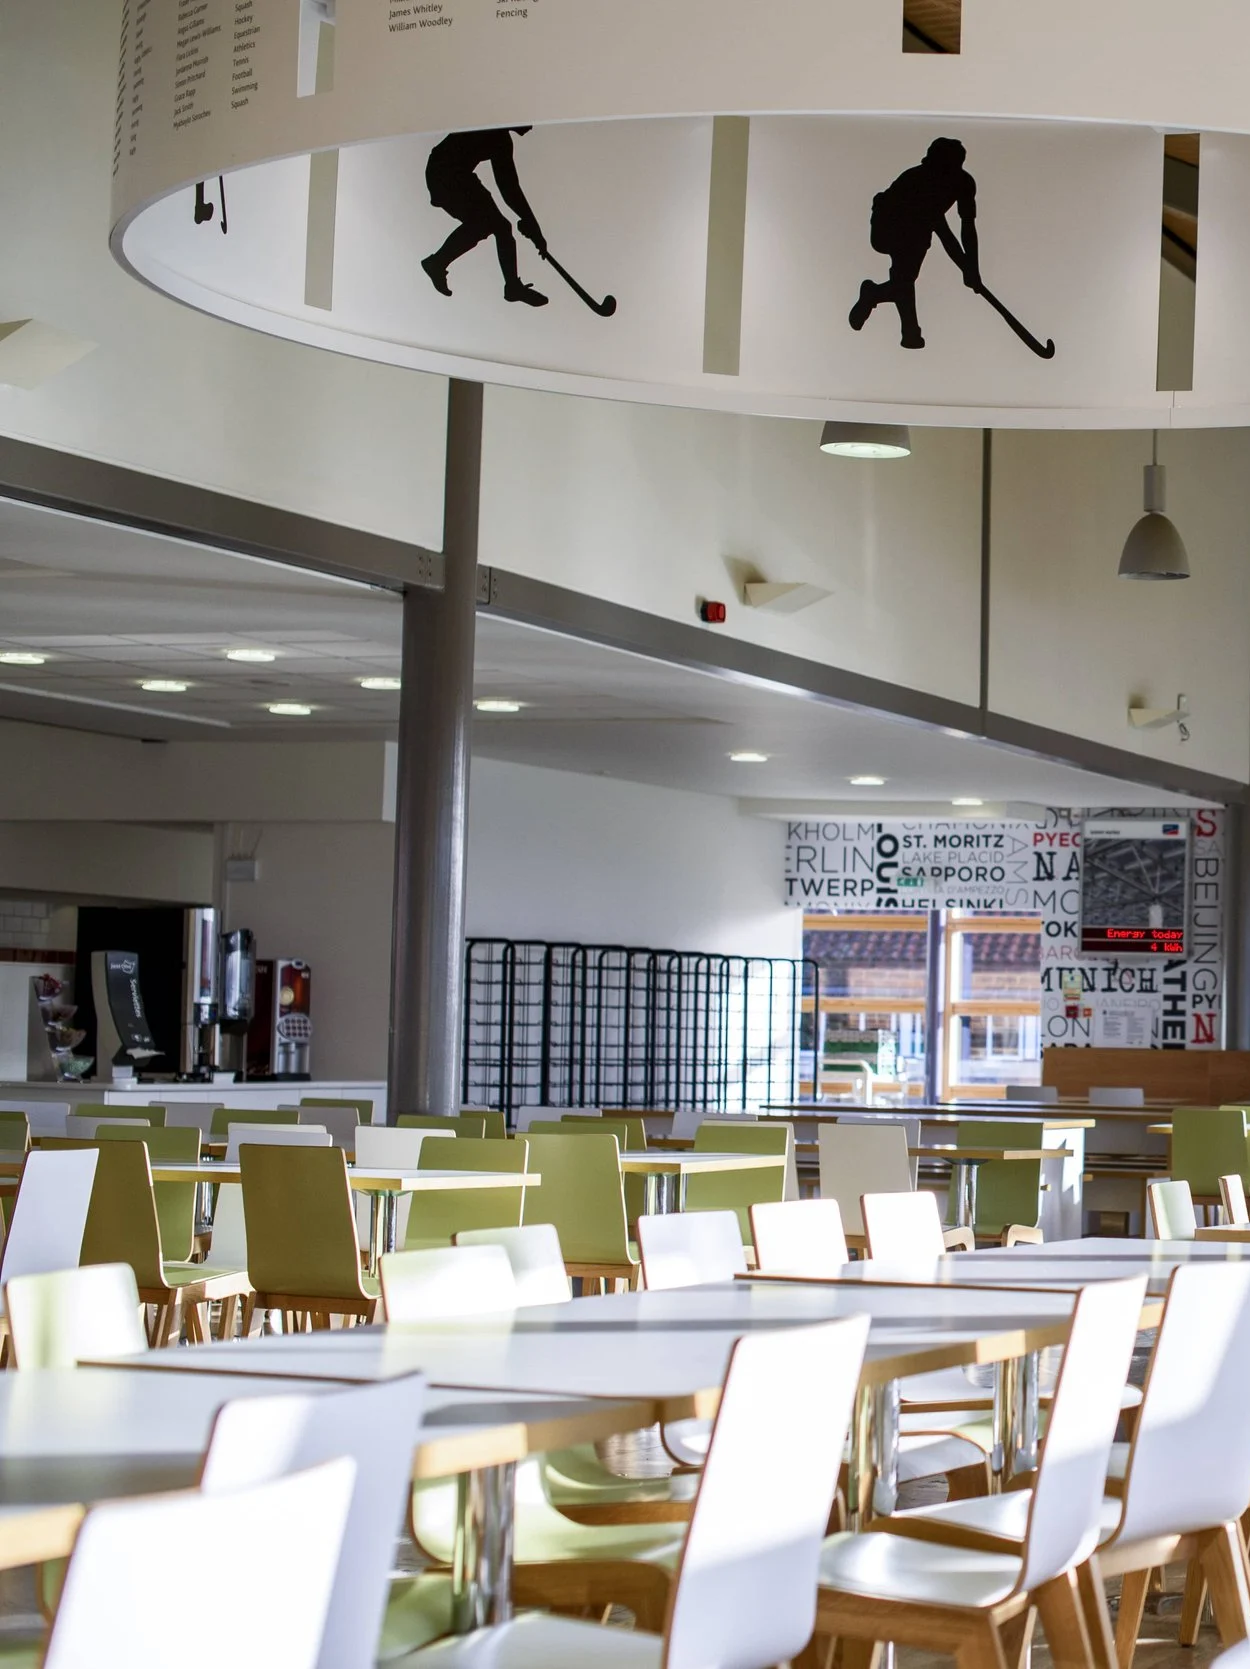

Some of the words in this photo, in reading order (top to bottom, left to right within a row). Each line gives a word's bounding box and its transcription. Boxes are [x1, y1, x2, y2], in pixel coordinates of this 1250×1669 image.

[235, 1, 253, 13] Squash
[389, 8, 410, 20] James
[413, 4, 443, 15] Whitley
[496, 8, 528, 18] Fencing
[235, 15, 253, 25] Hockey
[389, 22, 416, 32] William
[419, 17, 453, 28] Woodley
[234, 26, 260, 39] Equestrian
[234, 41, 256, 52] Athletics
[233, 56, 249, 67] Tennis
[232, 69, 253, 81] Football
[232, 82, 258, 95] Swimming
[231, 98, 249, 109] Squash
[902, 835, 927, 848] ST.
[934, 835, 1004, 848] MORITZ
[902, 852, 942, 863] LAKE
[948, 852, 1004, 864] PLACID
[902, 867, 1005, 881] SAPPORO
[1192, 857, 1219, 991] BEIJING
[1107, 928, 1145, 939] Energy
[1151, 928, 1183, 939] today
[1151, 943, 1157, 951] 4
